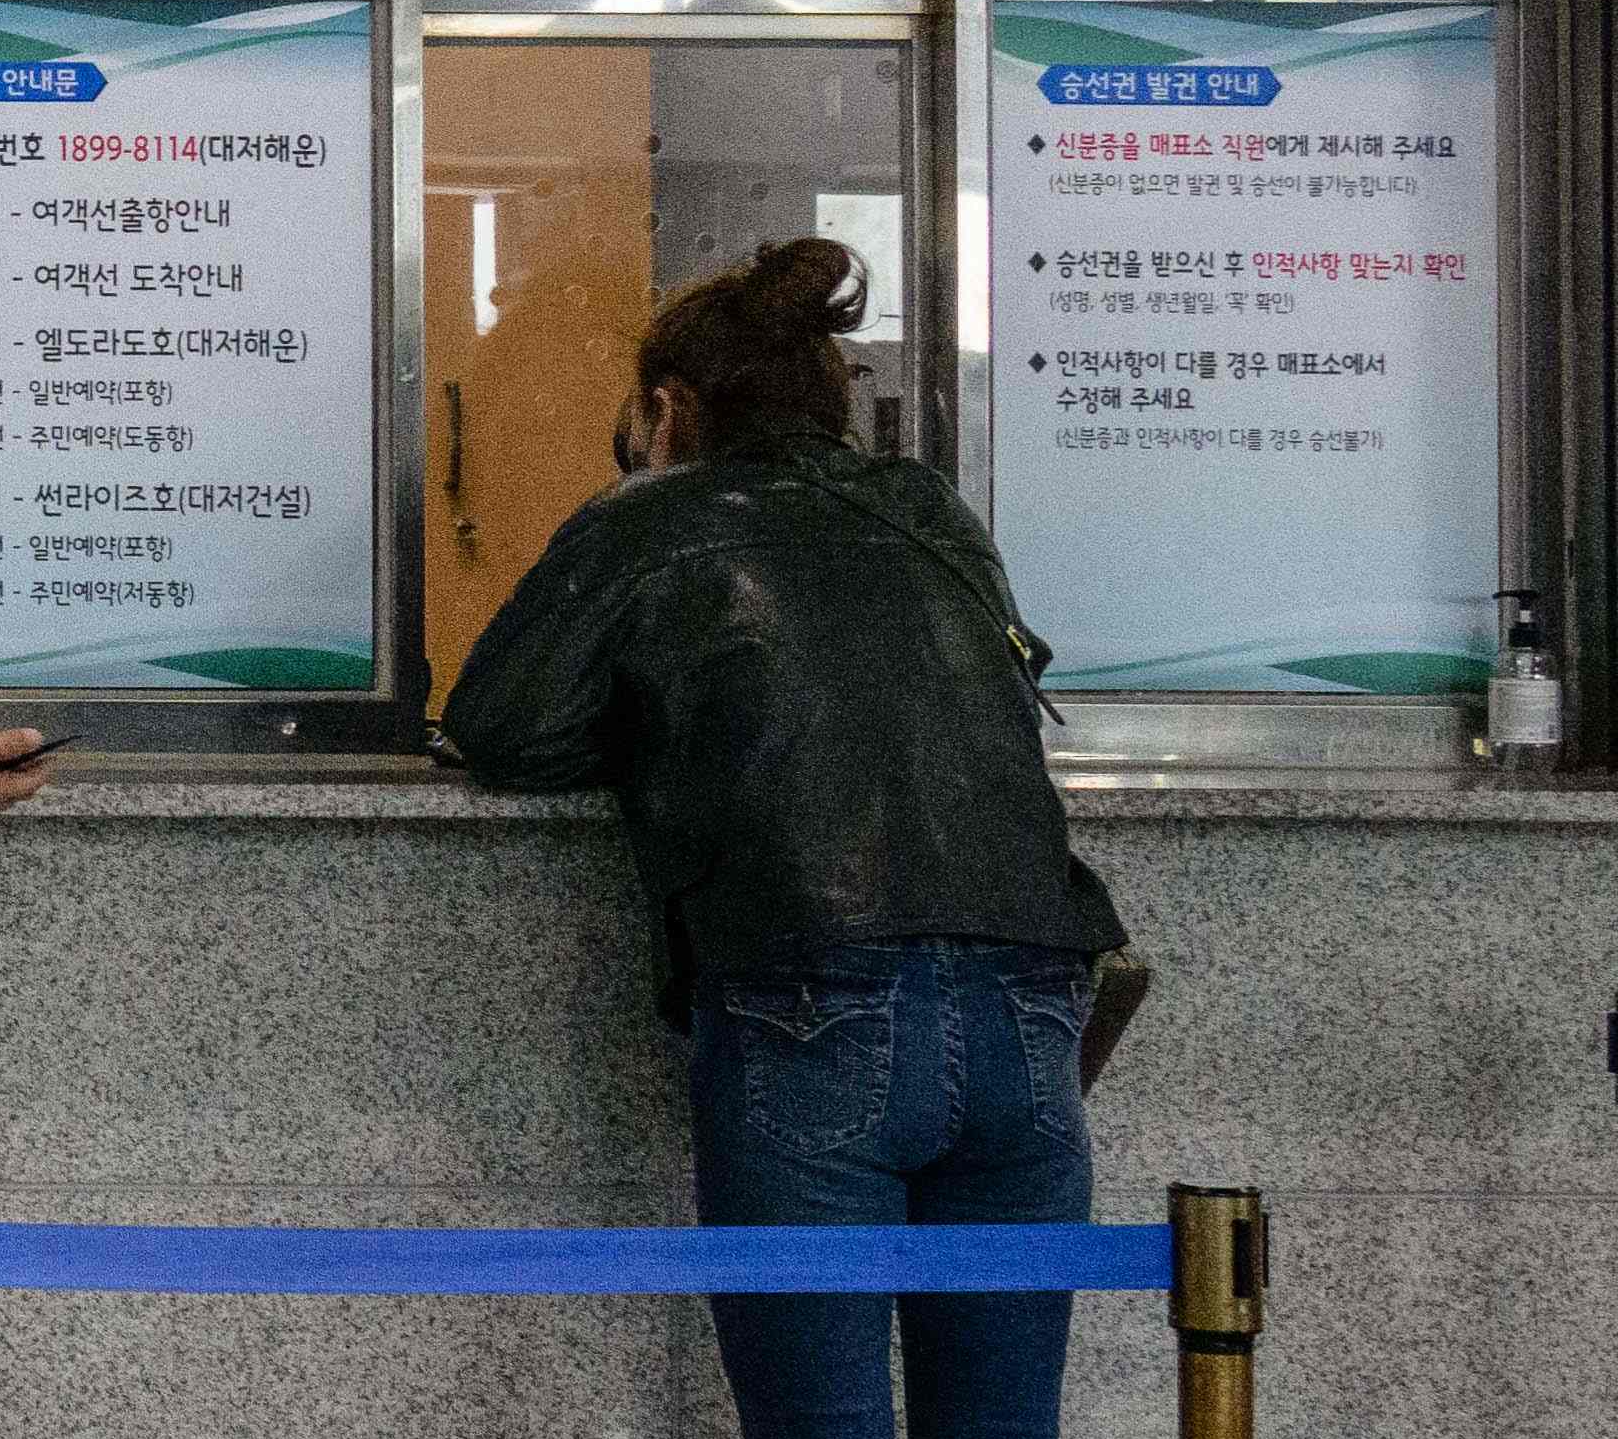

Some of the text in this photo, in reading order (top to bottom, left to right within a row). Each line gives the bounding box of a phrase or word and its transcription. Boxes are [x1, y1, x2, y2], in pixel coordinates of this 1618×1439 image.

[2, 68, 79, 98] 안내문
[1060, 71, 1259, 102] 승선권 발권 안내
[59, 133, 327, 169] 1899-8114(대저해운)
[1056, 132, 1459, 162] 신분증을 매표소 직원에게 제시해 주세요
[31, 197, 231, 235] 여객선출항안내
[33, 263, 118, 298] 여객선
[130, 262, 243, 299] 도착안내
[1056, 249, 1143, 280] 승선권을
[1150, 250, 1215, 279] 받으신
[1223, 250, 1245, 277] 후
[1252, 252, 1341, 281] 인적사항
[1422, 252, 1469, 283] 확인
[34, 327, 309, 365] 엘도라도호(대저해운)
[28, 379, 173, 408] 일반예약(포항)
[1056, 386, 1195, 415] 수정해 주세요
[29, 424, 194, 454] 주민예약(도동항)
[34, 483, 312, 520] 썬라이즈호(대저건설)
[28, 534, 173, 564] 일반예약(포항)
[30, 579, 195, 609] 주민예약(저동항)
